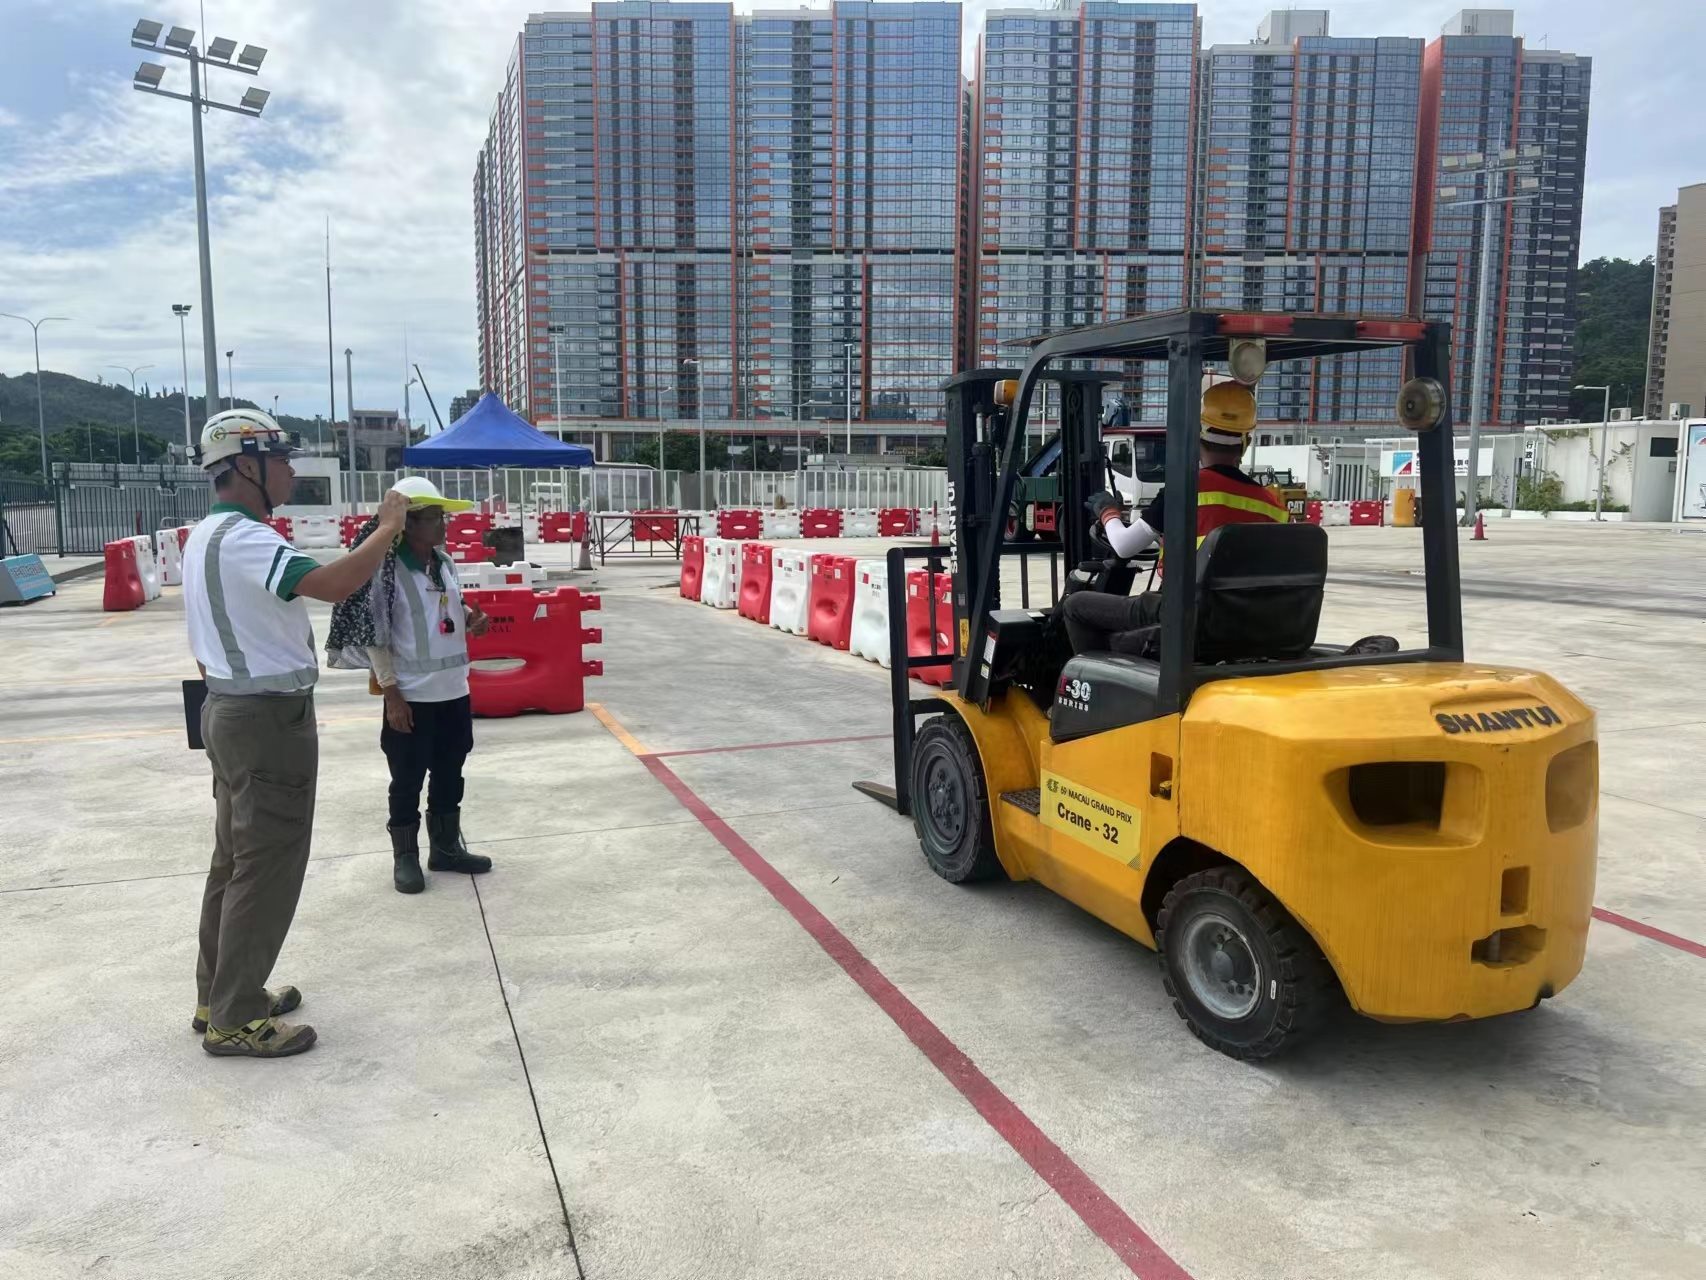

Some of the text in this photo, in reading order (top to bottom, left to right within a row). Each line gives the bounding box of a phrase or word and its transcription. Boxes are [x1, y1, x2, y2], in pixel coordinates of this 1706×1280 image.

[1287, 500, 1304, 514] CAT
[948, 481, 958, 574] SHANTUI
[1435, 706, 1562, 734] SHANTUI
[1057, 802, 1092, 831] Crane
[1103, 823, 1119, 844] 32
[1068, 789, 1089, 806] MACAU
[1091, 799, 1114, 816] GRAND
[1116, 810, 1132, 824] PRIX
